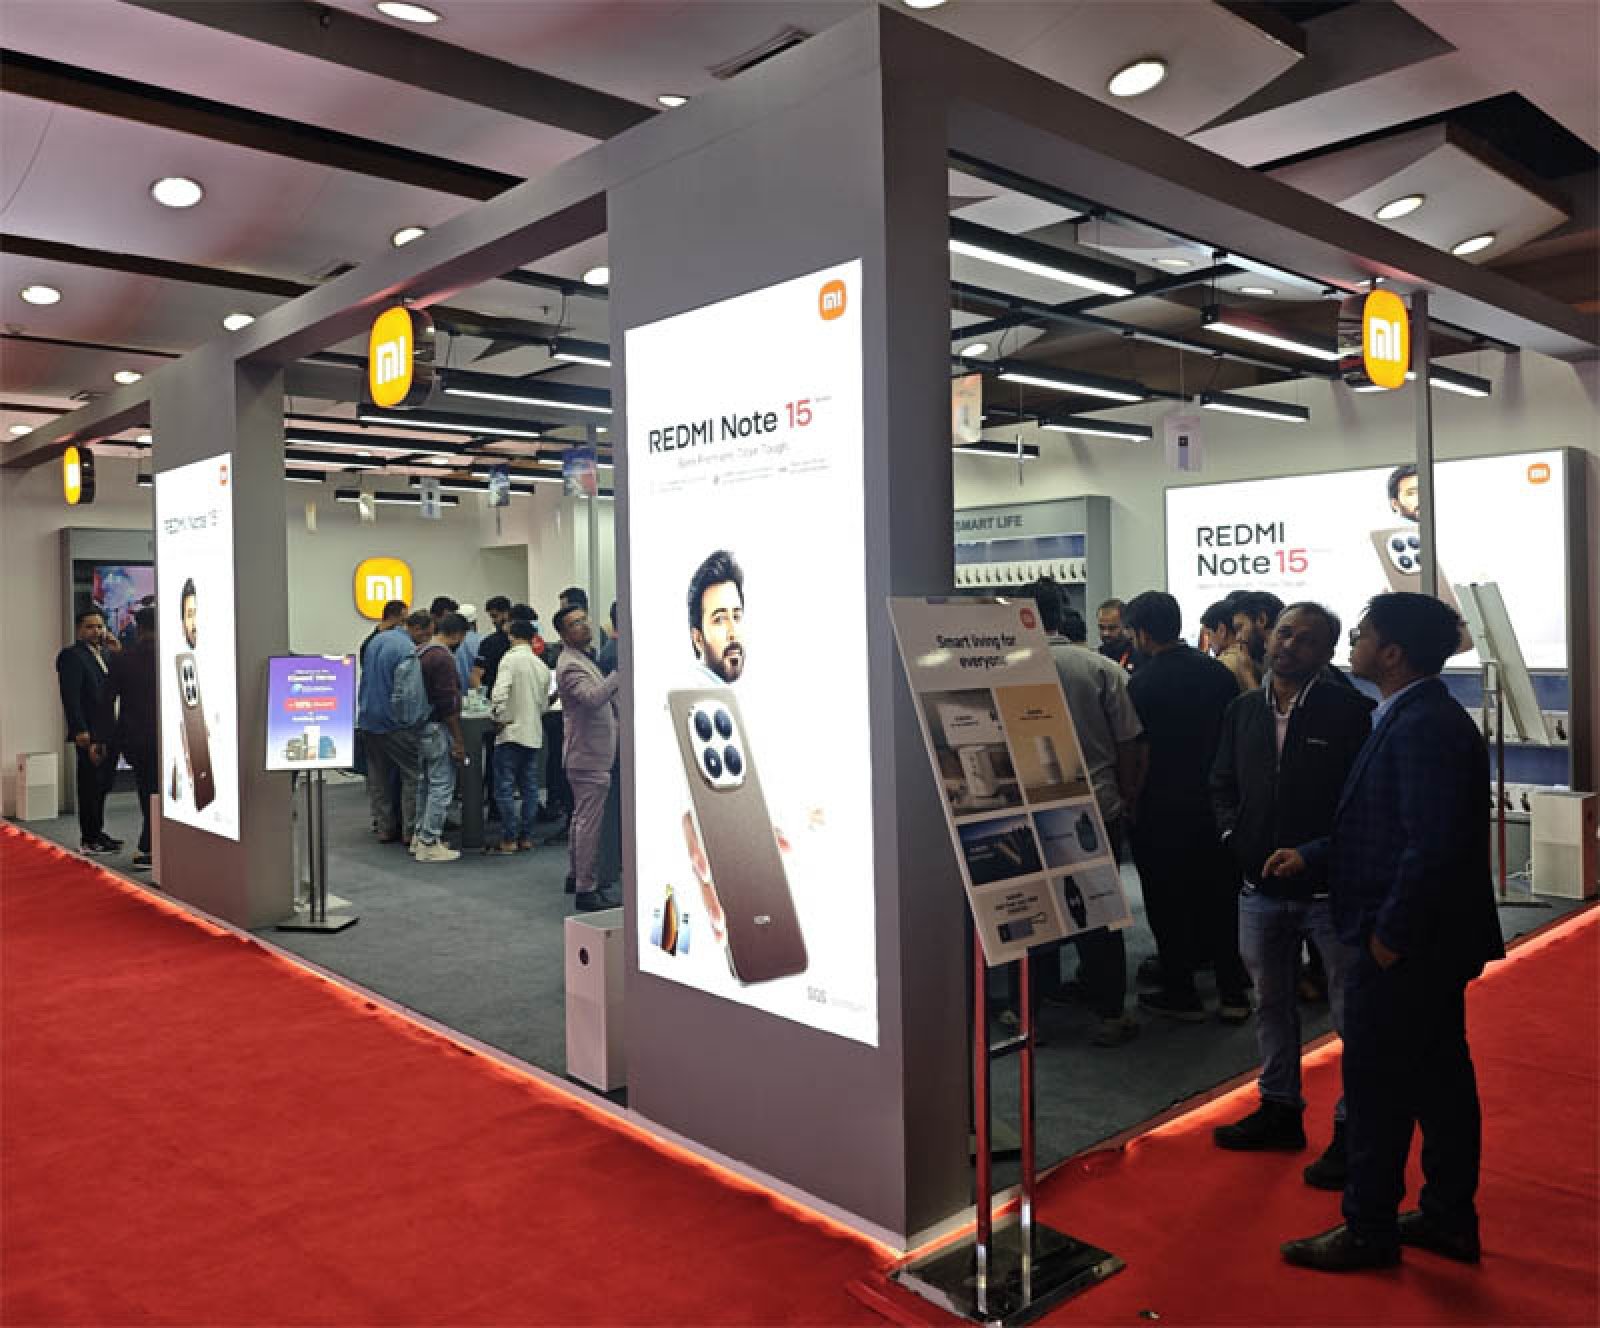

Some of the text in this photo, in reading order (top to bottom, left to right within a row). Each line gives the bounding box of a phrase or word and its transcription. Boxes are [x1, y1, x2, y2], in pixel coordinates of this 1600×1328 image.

[648, 419, 713, 454] REDMI
[720, 410, 778, 441] Note
[785, 399, 812, 429] 15
[1196, 521, 1285, 548] REDMI
[1197, 548, 1309, 576] Note 15
[936, 634, 969, 649] Smart
